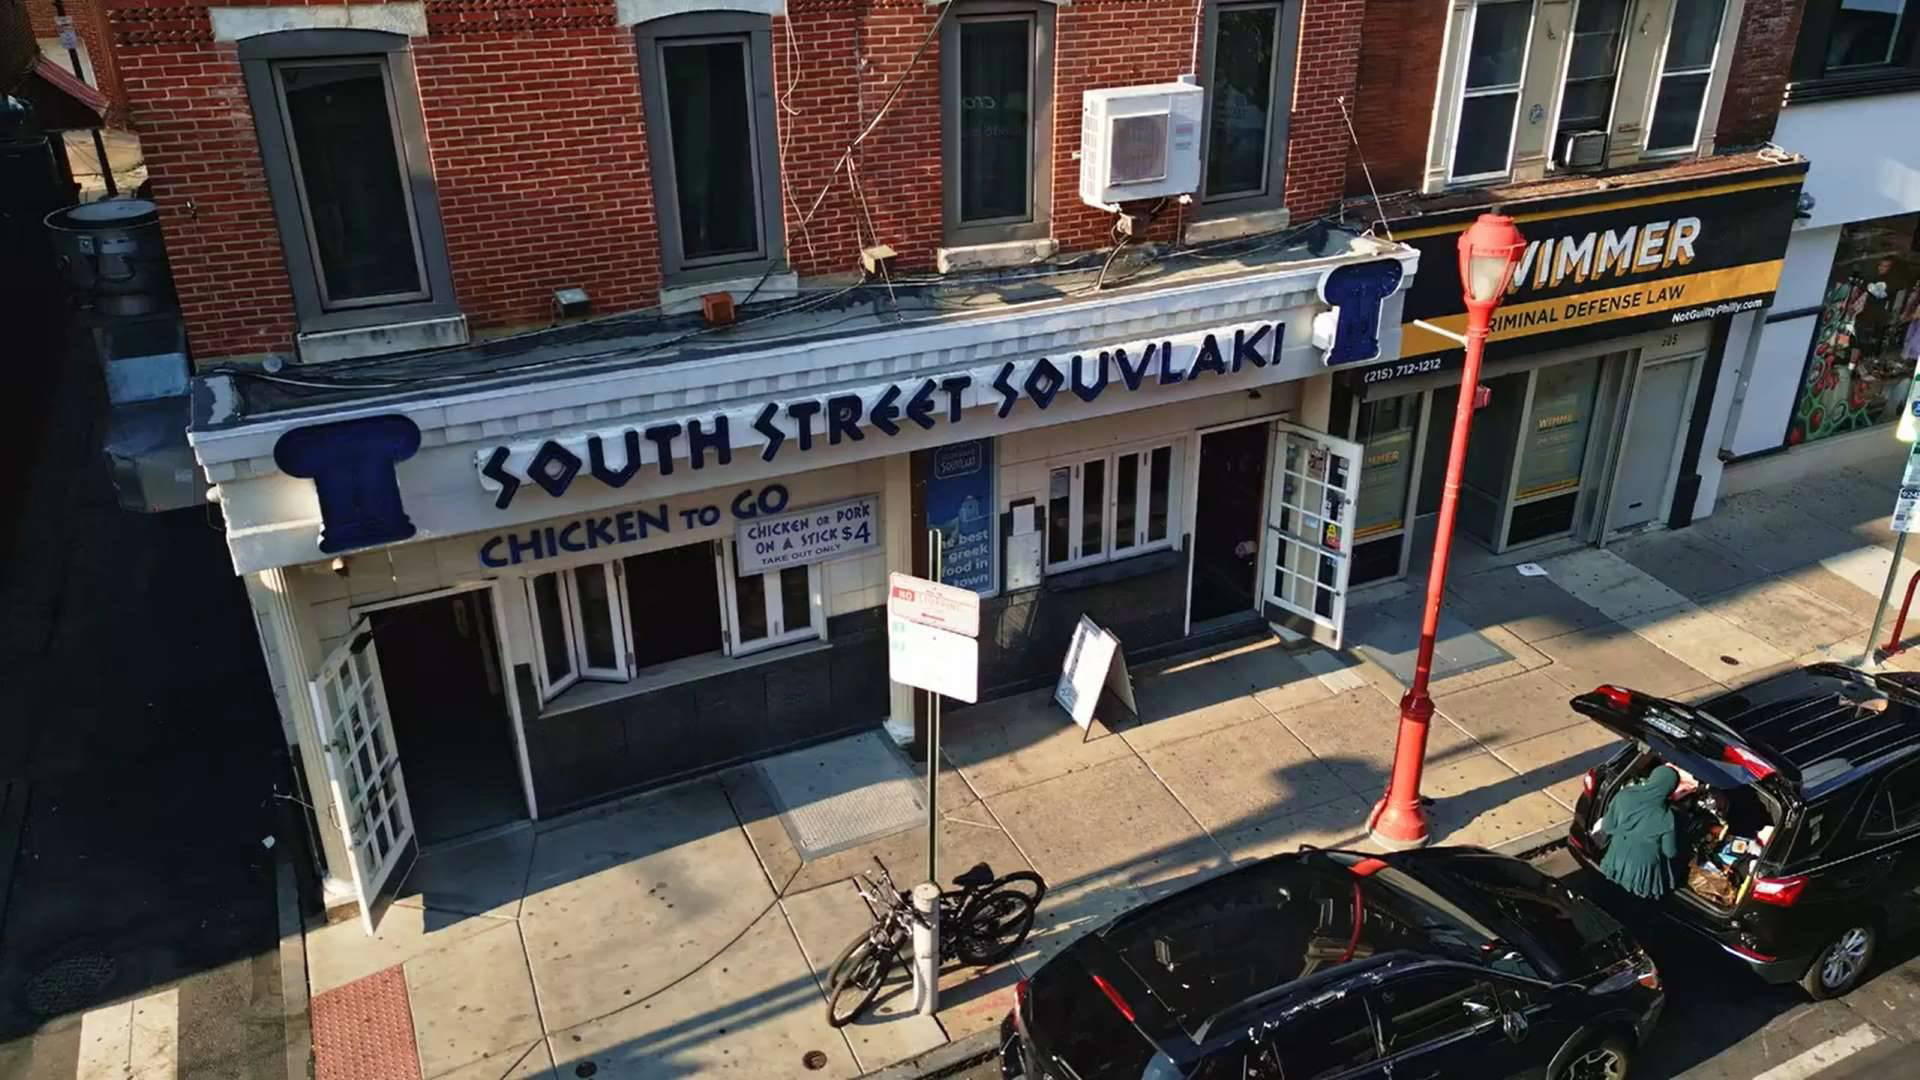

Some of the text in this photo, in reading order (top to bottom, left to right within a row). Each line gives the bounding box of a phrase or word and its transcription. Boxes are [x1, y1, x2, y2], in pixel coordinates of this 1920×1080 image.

[1488, 284, 1685, 332] RIMINAL DEFENSE LAW
[1671, 299, 1763, 324] NotGuiltyPhilly.com
[1363, 358, 1441, 384] (215) 712-1212
[482, 321, 1287, 510] SOUTH STREET SOUVLAKI
[1537, 413, 1577, 430] WIMM
[480, 483, 789, 569] CHICKEN TO GO
[747, 502, 870, 540] CHICKEN OR PORK
[755, 520, 871, 555] ON A STICK $4
[959, 529, 988, 544] best
[761, 543, 841, 565] TAKE OUT ONLY
[948, 543, 988, 563] greek
[975, 558, 988, 569] in
[953, 574, 988, 587] town
